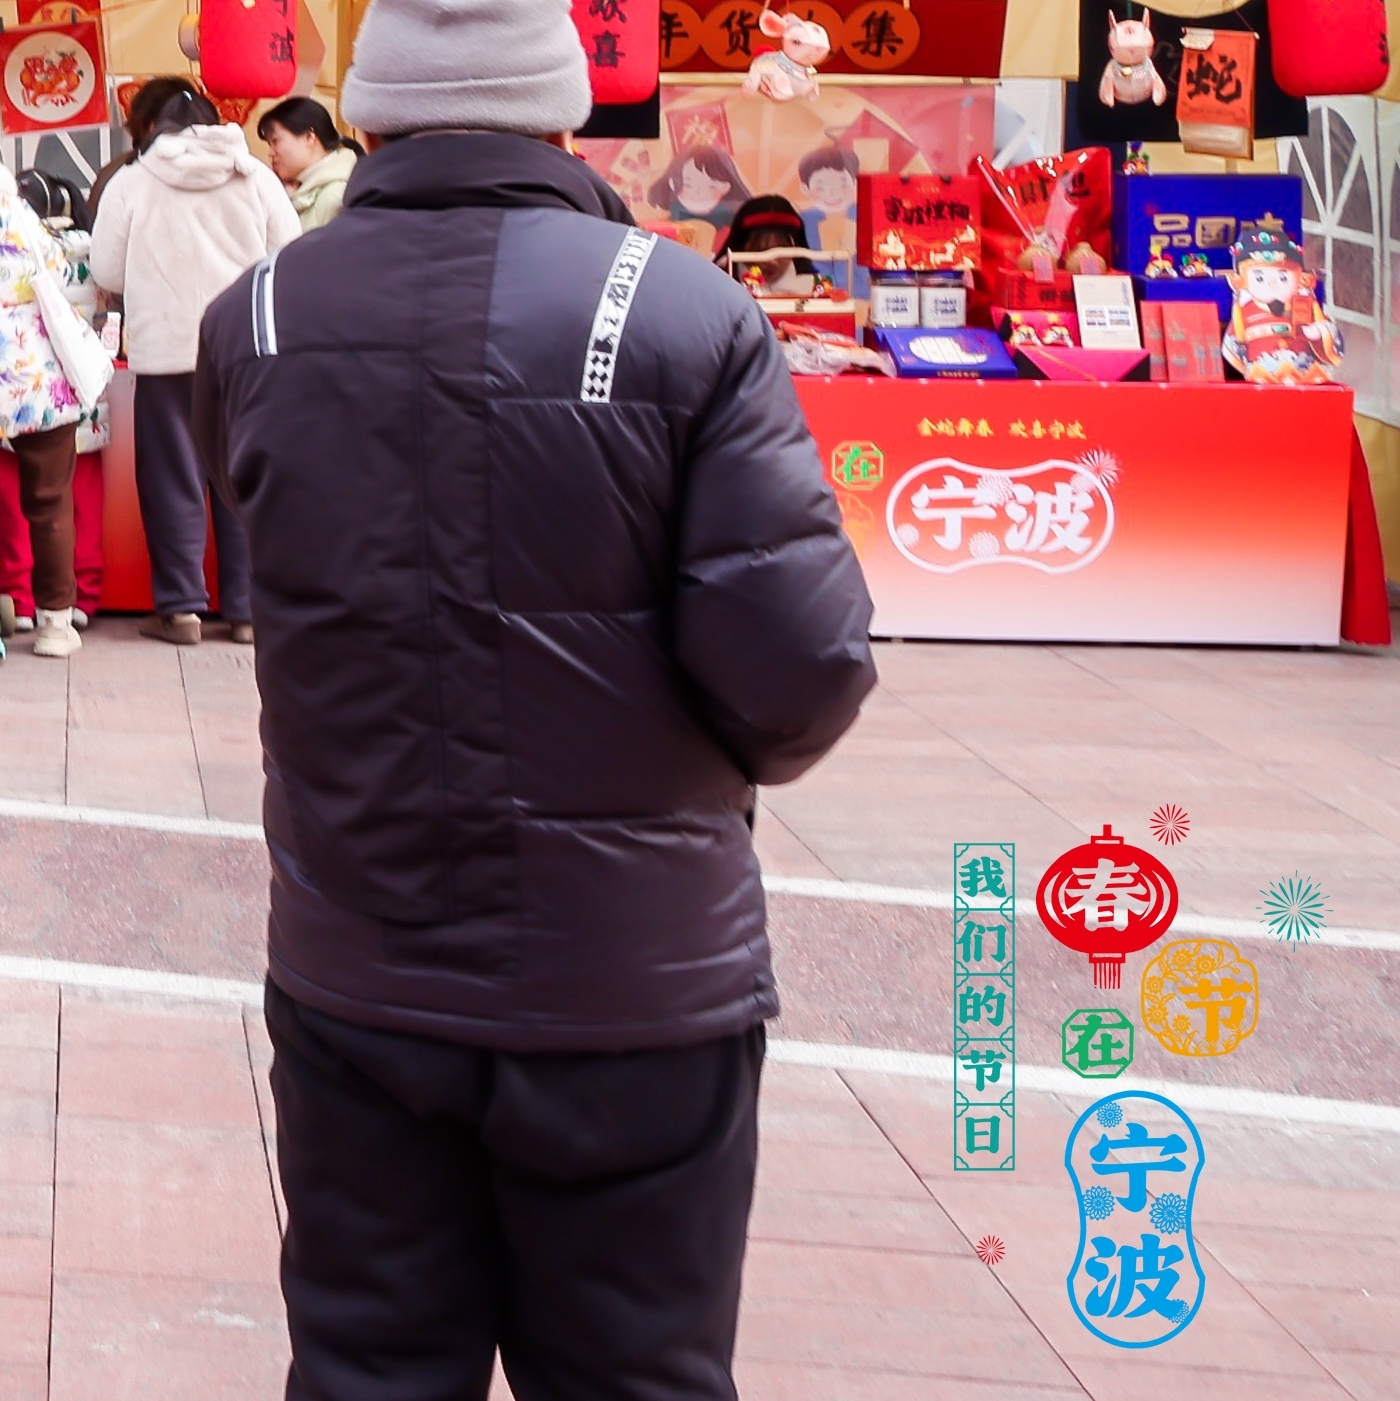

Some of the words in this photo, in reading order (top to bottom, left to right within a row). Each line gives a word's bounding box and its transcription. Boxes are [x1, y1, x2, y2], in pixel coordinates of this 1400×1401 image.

[660, 9, 904, 59] 年货集
[1186, 53, 1243, 104] 蛇
[911, 475, 1095, 555] 宁波
